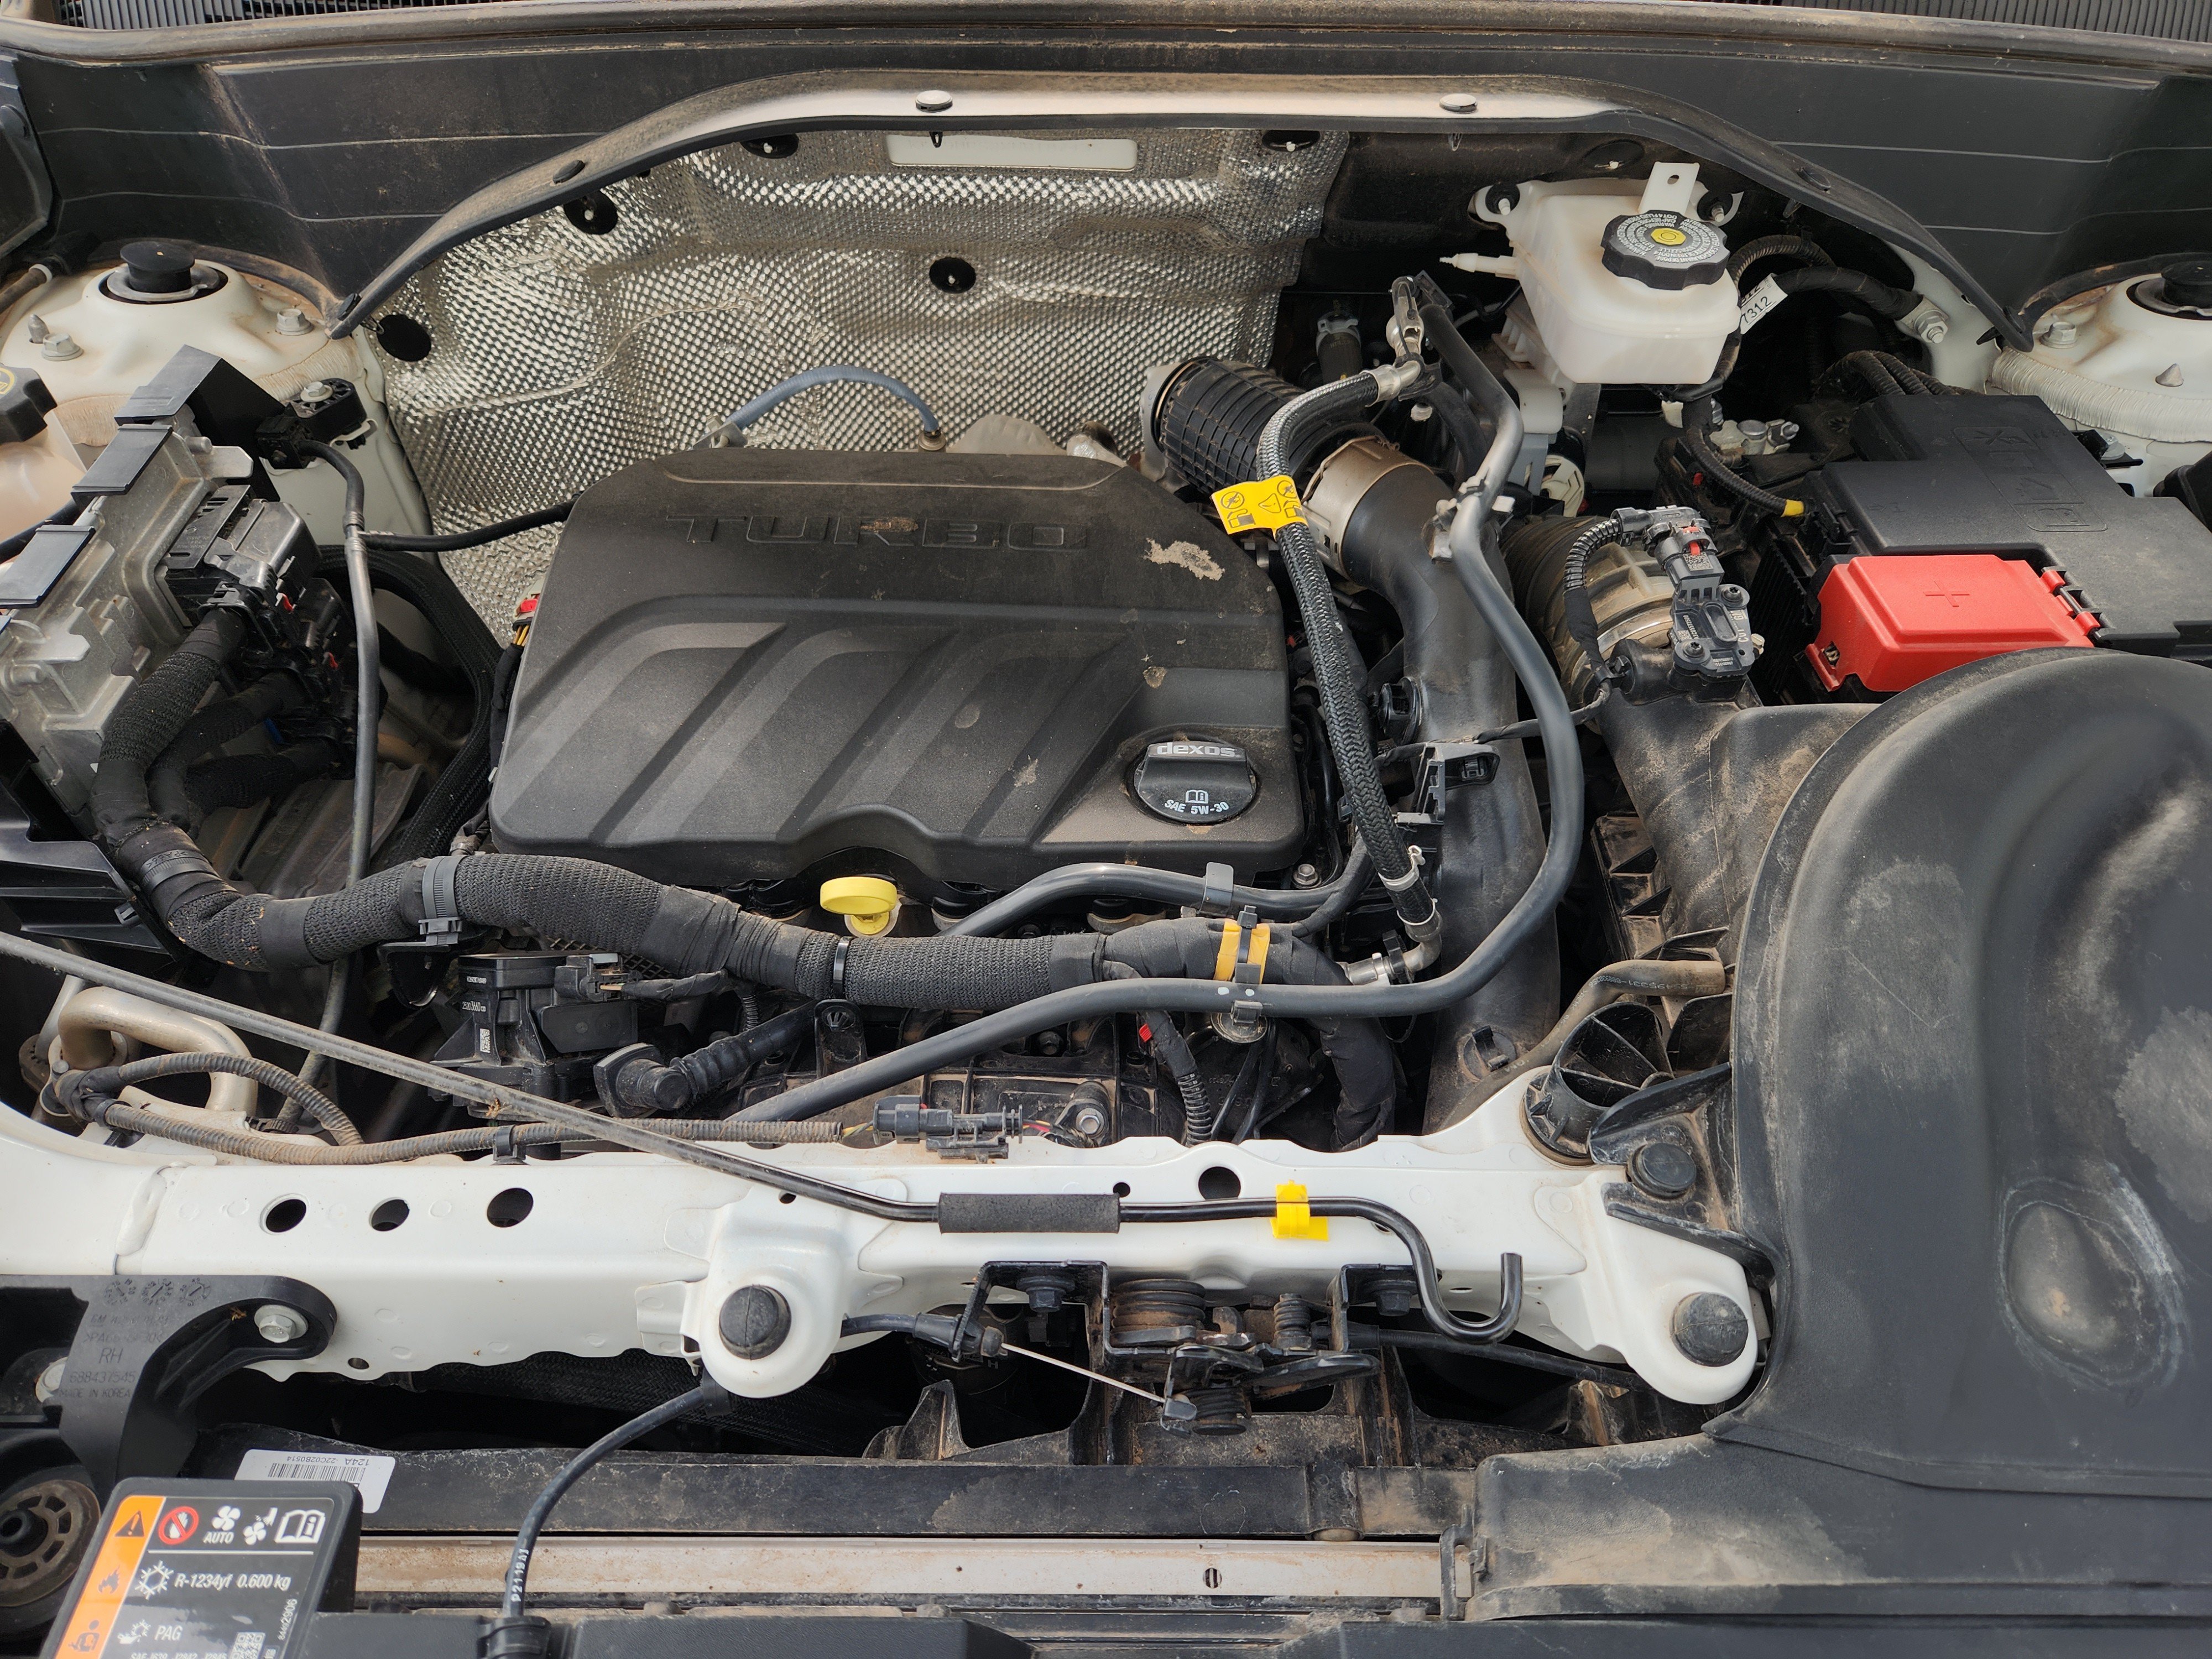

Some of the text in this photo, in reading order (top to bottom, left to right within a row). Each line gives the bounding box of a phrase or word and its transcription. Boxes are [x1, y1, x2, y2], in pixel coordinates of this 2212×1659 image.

[1741, 296, 1772, 324] 7312
[666, 515, 1087, 549] TURBO
[1157, 742, 1237, 757] dexos
[1164, 799, 1230, 815] SAE 5W-30
[98, 1347, 123, 1364] RH
[60, 1388, 131, 1398] MADE IN KOREA
[345, 1458, 370, 1466] 124A
[203, 1532, 234, 1545] AUTO
[174, 1573, 291, 1590] R-1234yf 0.600 kg
[154, 1625, 182, 1641] PAG
